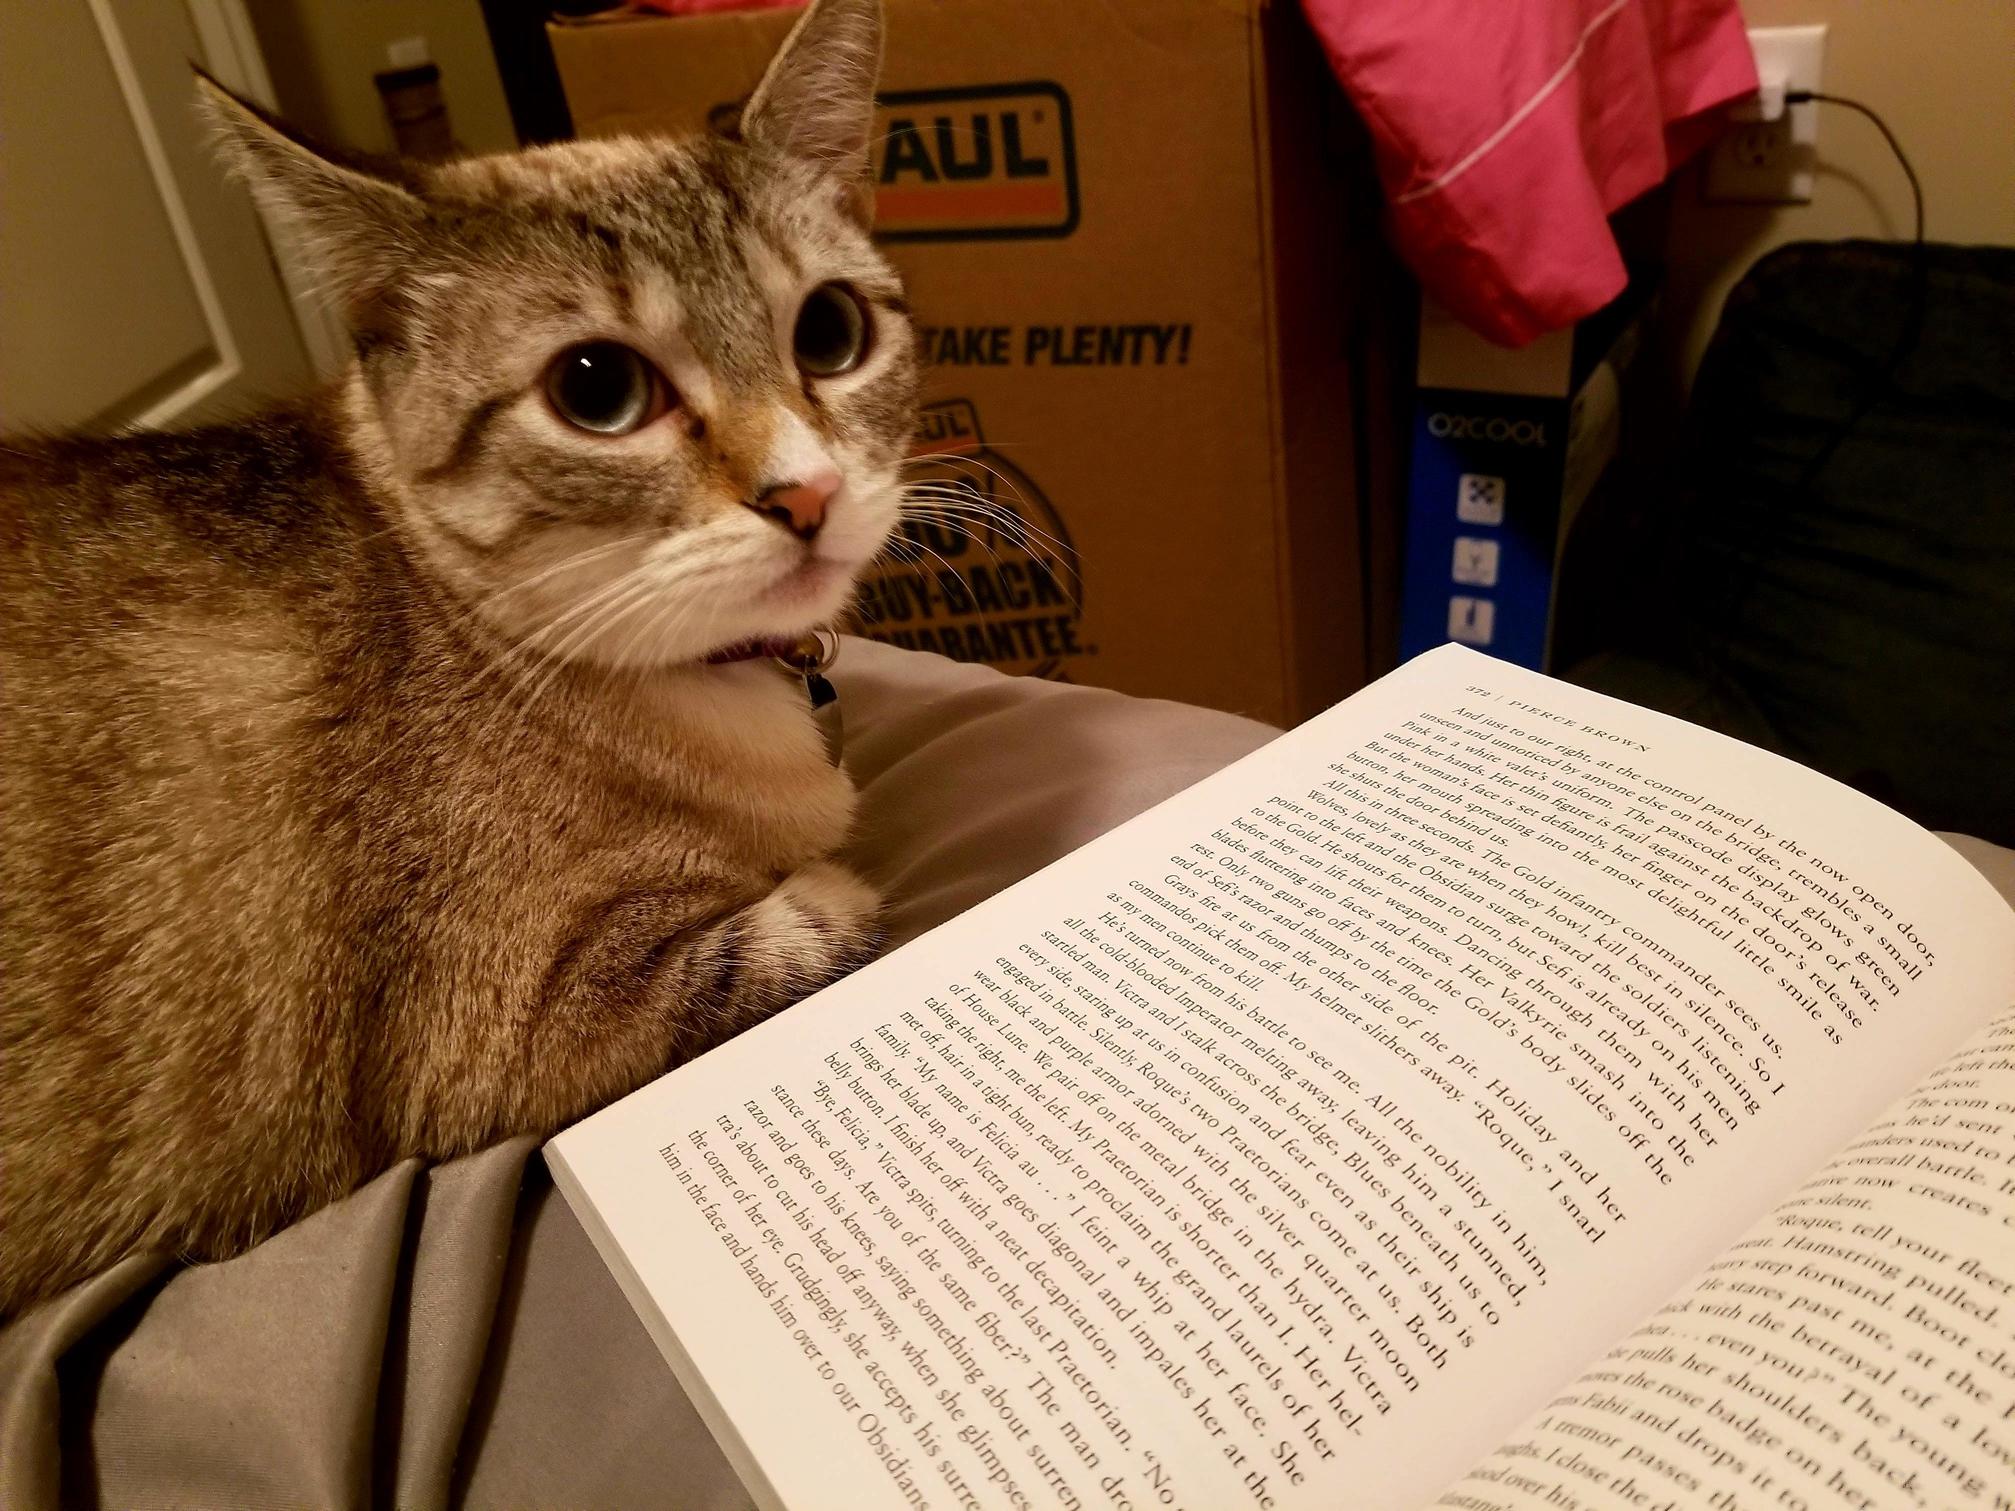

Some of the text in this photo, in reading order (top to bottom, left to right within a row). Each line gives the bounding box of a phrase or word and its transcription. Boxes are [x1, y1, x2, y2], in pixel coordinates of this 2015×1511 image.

[879, 111, 1050, 183] AUL
[922, 324, 1193, 366] TAKE PLENTY!
[1210, 828, 1695, 1167] blades fluttering into faces and knees. Her Valkyrie smash into the
[1265, 795, 1761, 1117] point to the left and the Obsidian surge toward the soldiers listening
[1345, 749, 1844, 1046] button, her mouth spreading into the most delightful little smile as
[1400, 720, 1432, 737] Pink
[1431, 732, 1449, 744] in
[1449, 740, 1461, 748] a
[1464, 745, 1502, 764] white
[1550, 779, 1614, 811] uniform.
[1622, 805, 1656, 827] The
[1653, 824, 1734, 865] passcode
[1736, 864, 1800, 904] display
[1799, 906, 1855, 948] glows
[1854, 950, 1901, 998] green
[1451, 706, 1936, 968] And just to our right, at the control panel by the now open door,
[972, 969, 1420, 1393] wear black and purple armor adorned with the silver quarter moon
[1062, 917, 1528, 1308] all the cold-blooded Imperator melting away, leaving him a stunned,
[1128, 879, 1199, 925] commandos
[1191, 921, 1227, 942] pick
[1223, 938, 1260, 962] them
[1257, 958, 1288, 977] off.
[1281, 970, 1312, 992] My
[1308, 986, 1364, 1026] helmet
[1360, 1023, 1421, 1067] slithers
[1419, 1065, 1466, 1103] away.
[1548, 1178, 1564, 1193] I
[1558, 1194, 1607, 1245] snarl
[657, 1141, 683, 1172] him
[675, 1169, 693, 1186] in
[685, 1183, 708, 1206] the
[700, 1202, 728, 1233] face
[720, 1231, 754, 1259] and
[739, 1253, 780, 1300] hands
[769, 1293, 798, 1330] him
[792, 1328, 824, 1361] over
[816, 1360, 837, 1381] to
[831, 1381, 862, 1413] our
[735, 1140, 770, 1176] about
[762, 1173, 780, 1190] to
[775, 1189, 799, 1212] cut
[791, 1206, 815, 1232] his
[808, 1226, 848, 1265] head
[835, 1263, 867, 1285] off
[851, 1284, 903, 1343] anyway,
[900, 1339, 940, 1388] when
[935, 1388, 966, 1423] she
[958, 1423, 1033, 1511] glimpses
[849, 1036, 1275, 1511] brings her blade up, and Victra goes diagonal and impales her at the
